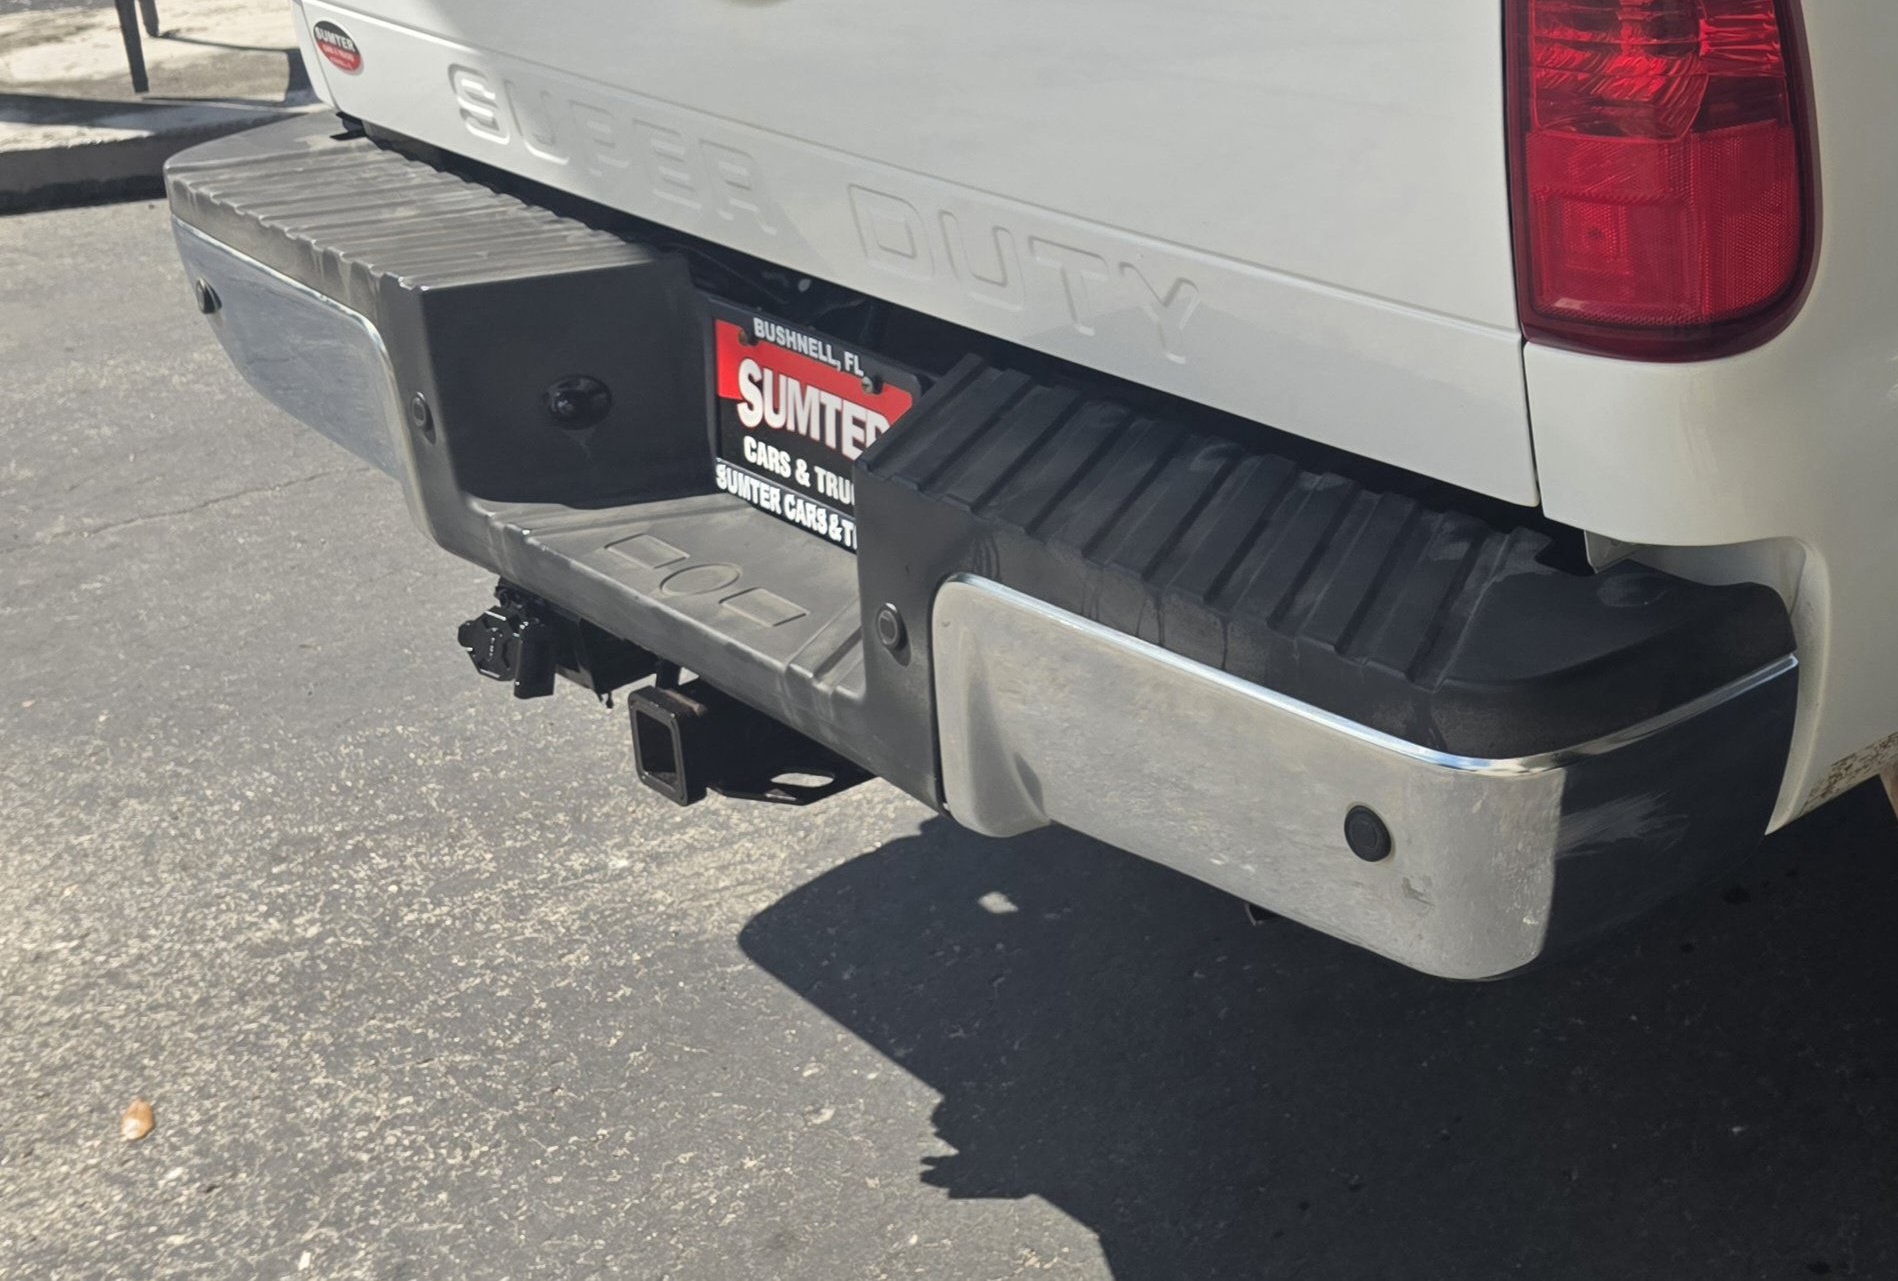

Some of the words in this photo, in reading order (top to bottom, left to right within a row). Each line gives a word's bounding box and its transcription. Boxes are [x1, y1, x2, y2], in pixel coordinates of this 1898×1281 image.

[314, 26, 356, 53] SUMTER
[447, 63, 777, 236] SUPER
[848, 183, 1201, 365] DUTY
[753, 317, 842, 372] BUSHNELL,
[844, 351, 865, 377] FL
[716, 463, 782, 515] SUMTER
[743, 435, 791, 478] CARS
[795, 458, 811, 488] &
[814, 465, 856, 506] TRU
